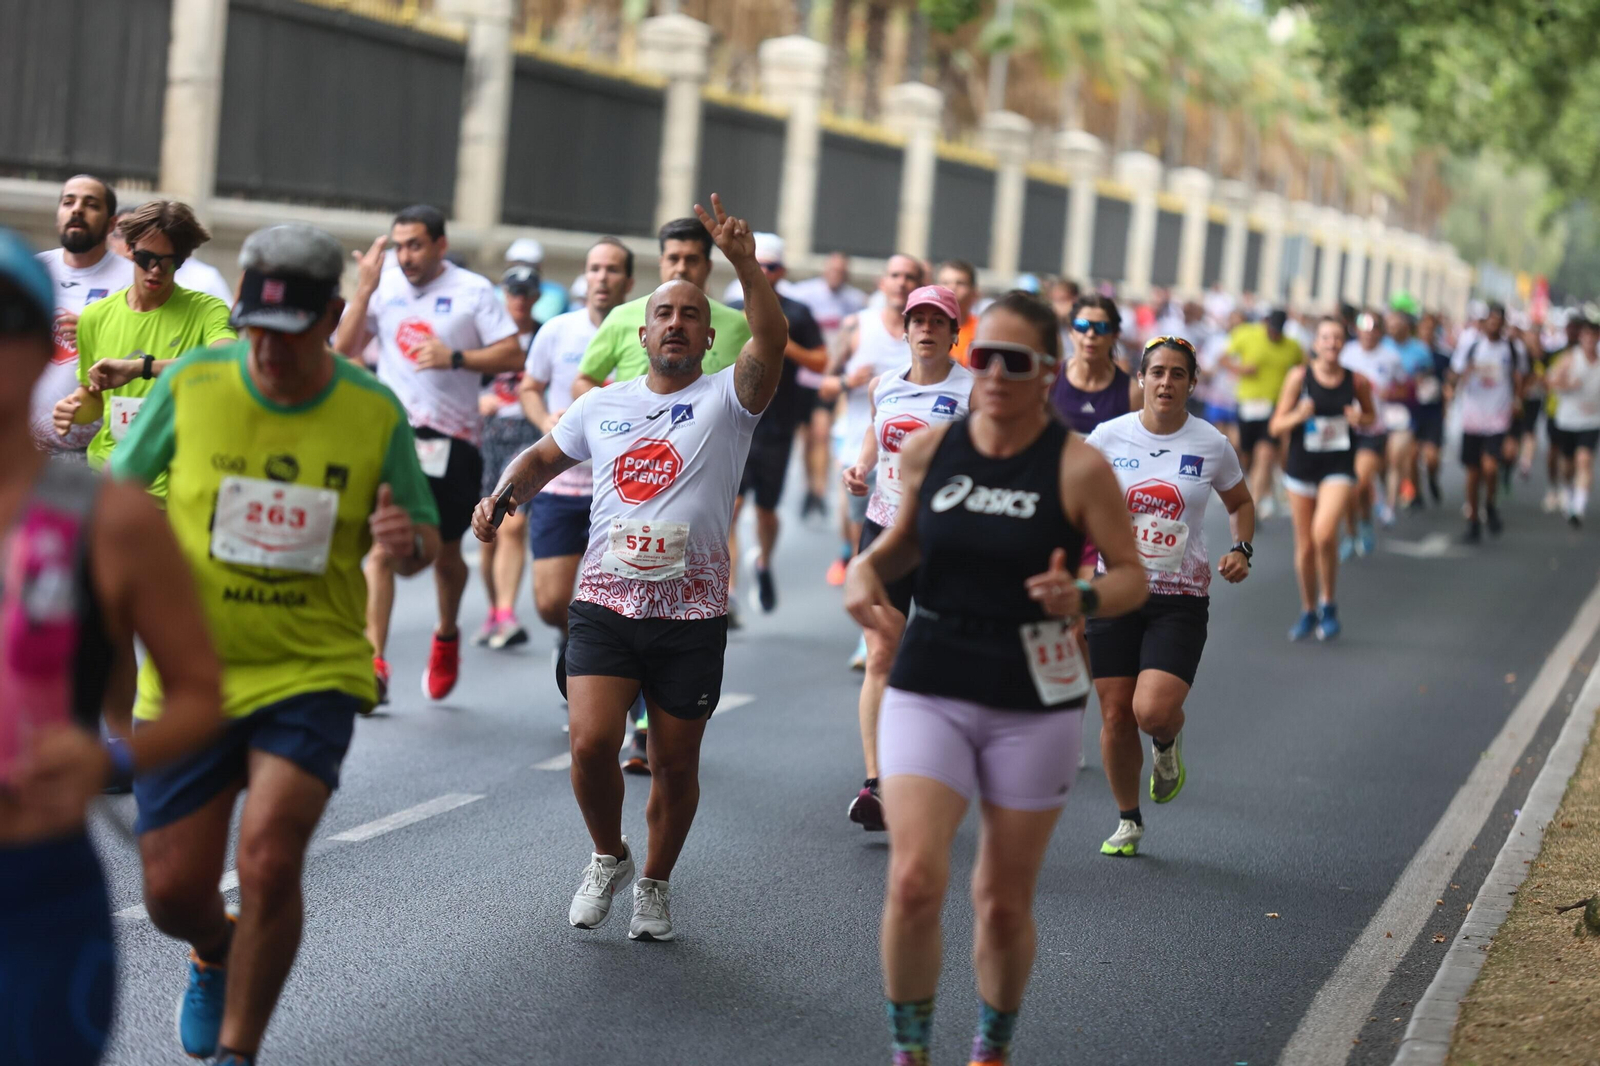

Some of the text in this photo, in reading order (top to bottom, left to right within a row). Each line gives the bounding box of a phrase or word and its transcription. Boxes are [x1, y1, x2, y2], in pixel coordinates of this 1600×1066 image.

[624, 457, 673, 473] PONLE
[623, 470, 670, 485] FRENO
[964, 485, 1041, 519] asics
[1134, 491, 1178, 513] PONLE
[245, 501, 307, 529] 263
[626, 534, 666, 553] 571
[1132, 525, 1177, 547] 1120
